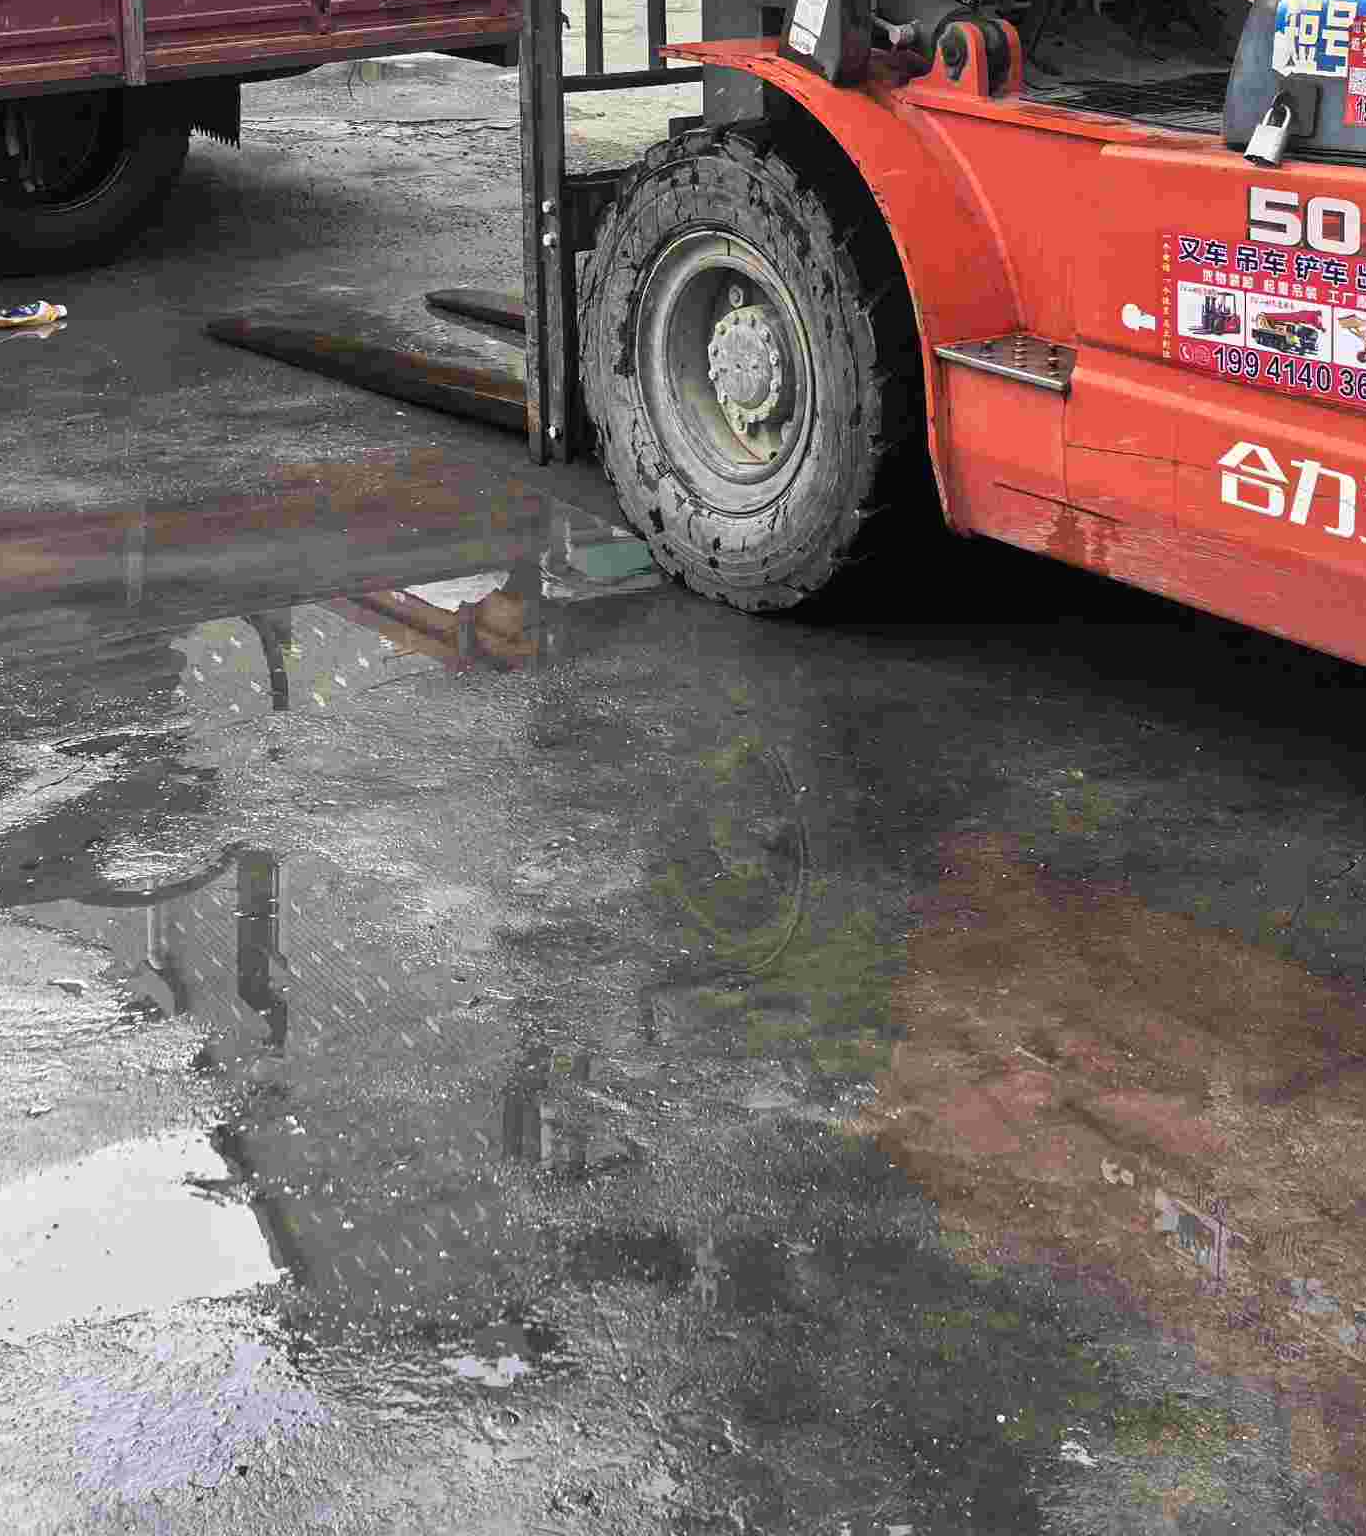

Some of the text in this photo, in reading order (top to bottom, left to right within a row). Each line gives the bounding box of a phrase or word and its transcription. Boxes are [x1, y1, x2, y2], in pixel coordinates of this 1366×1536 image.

[1247, 186, 1362, 256] 50
[1178, 235, 1228, 267] 叉车
[1235, 243, 1288, 278] 吊车
[1294, 252, 1348, 288] 铲车
[1211, 344, 1260, 380] 199
[1266, 354, 1332, 393] 4140
